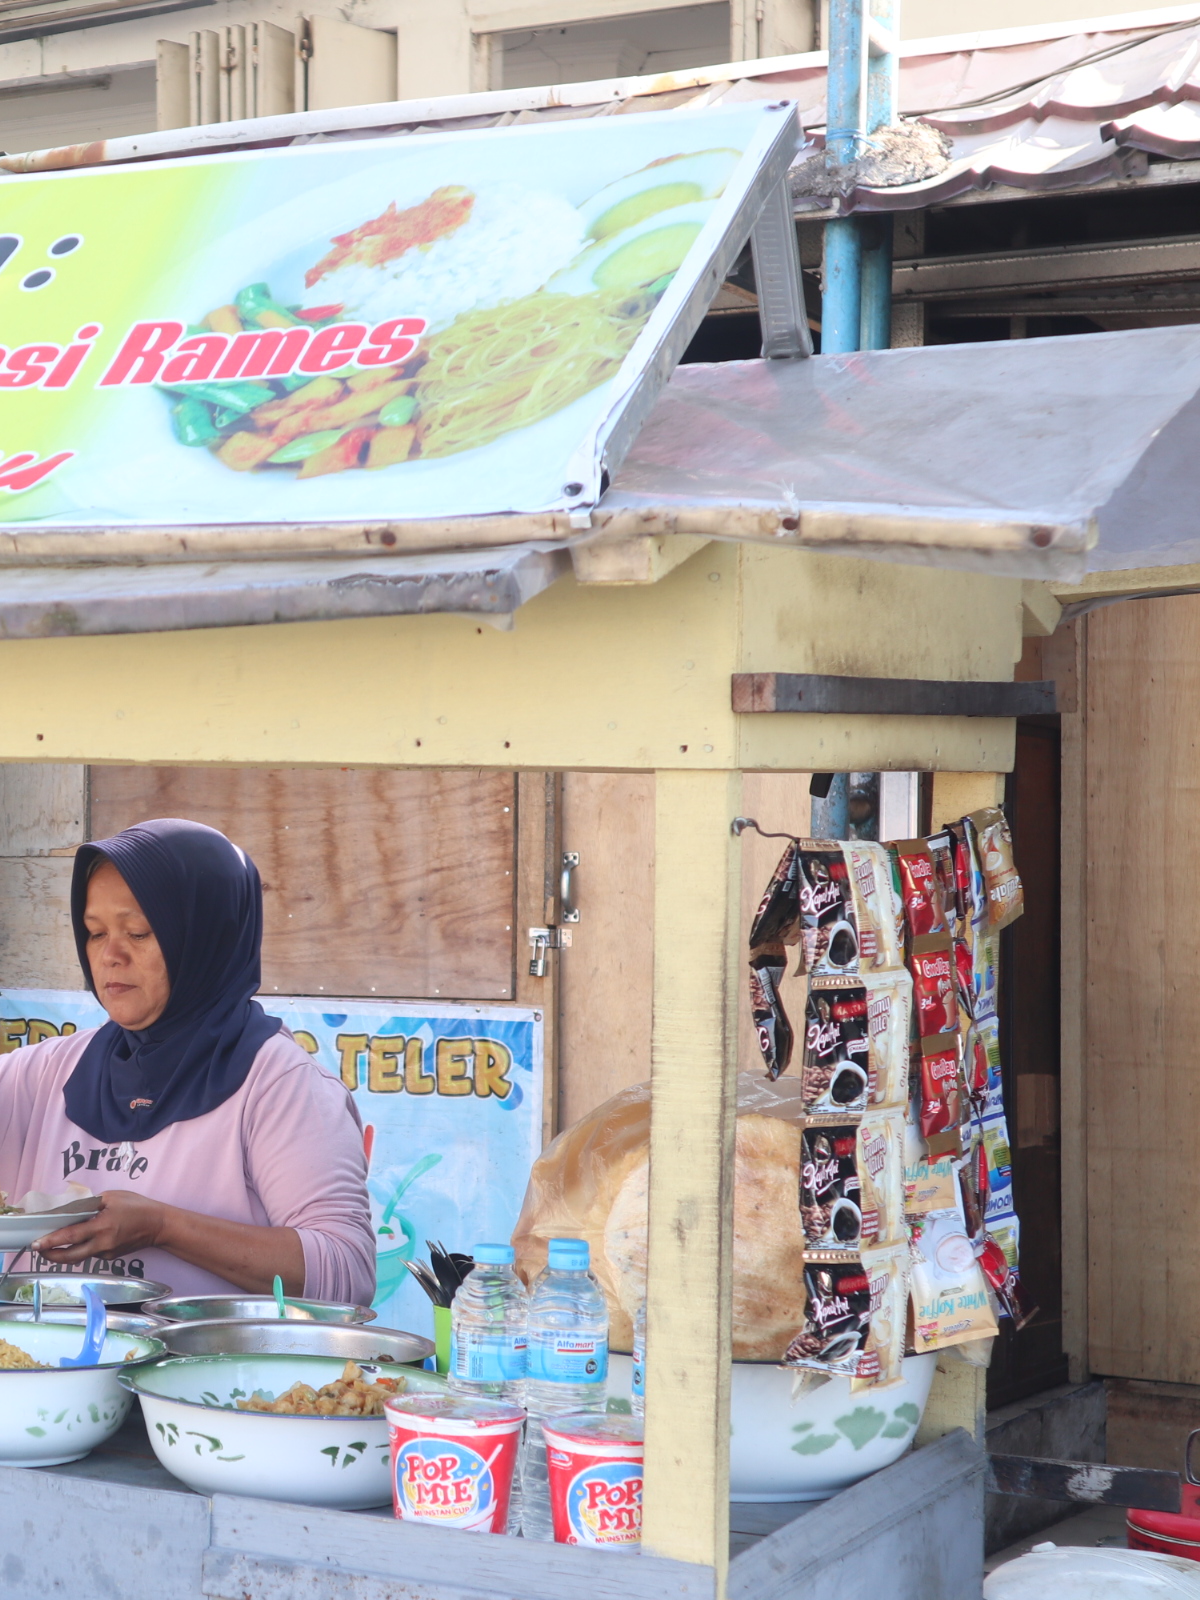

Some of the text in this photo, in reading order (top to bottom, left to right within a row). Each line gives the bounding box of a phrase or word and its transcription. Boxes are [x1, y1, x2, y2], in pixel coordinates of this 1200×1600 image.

[99, 317, 427, 386] Rames
[336, 1033, 512, 1099] TELER
[61, 1140, 149, 1180] Brae
[904, 1161, 929, 1182] Koffi
[919, 1291, 988, 1320] White Koffie
[557, 1340, 595, 1349] Alfamart
[406, 1455, 458, 1482] POP
[416, 1478, 472, 1506] MIE
[585, 1479, 643, 1510] POP
[453, 1507, 470, 1515] CUP
[598, 1505, 643, 1532] MI
[607, 1533, 636, 1543] INSTAN
